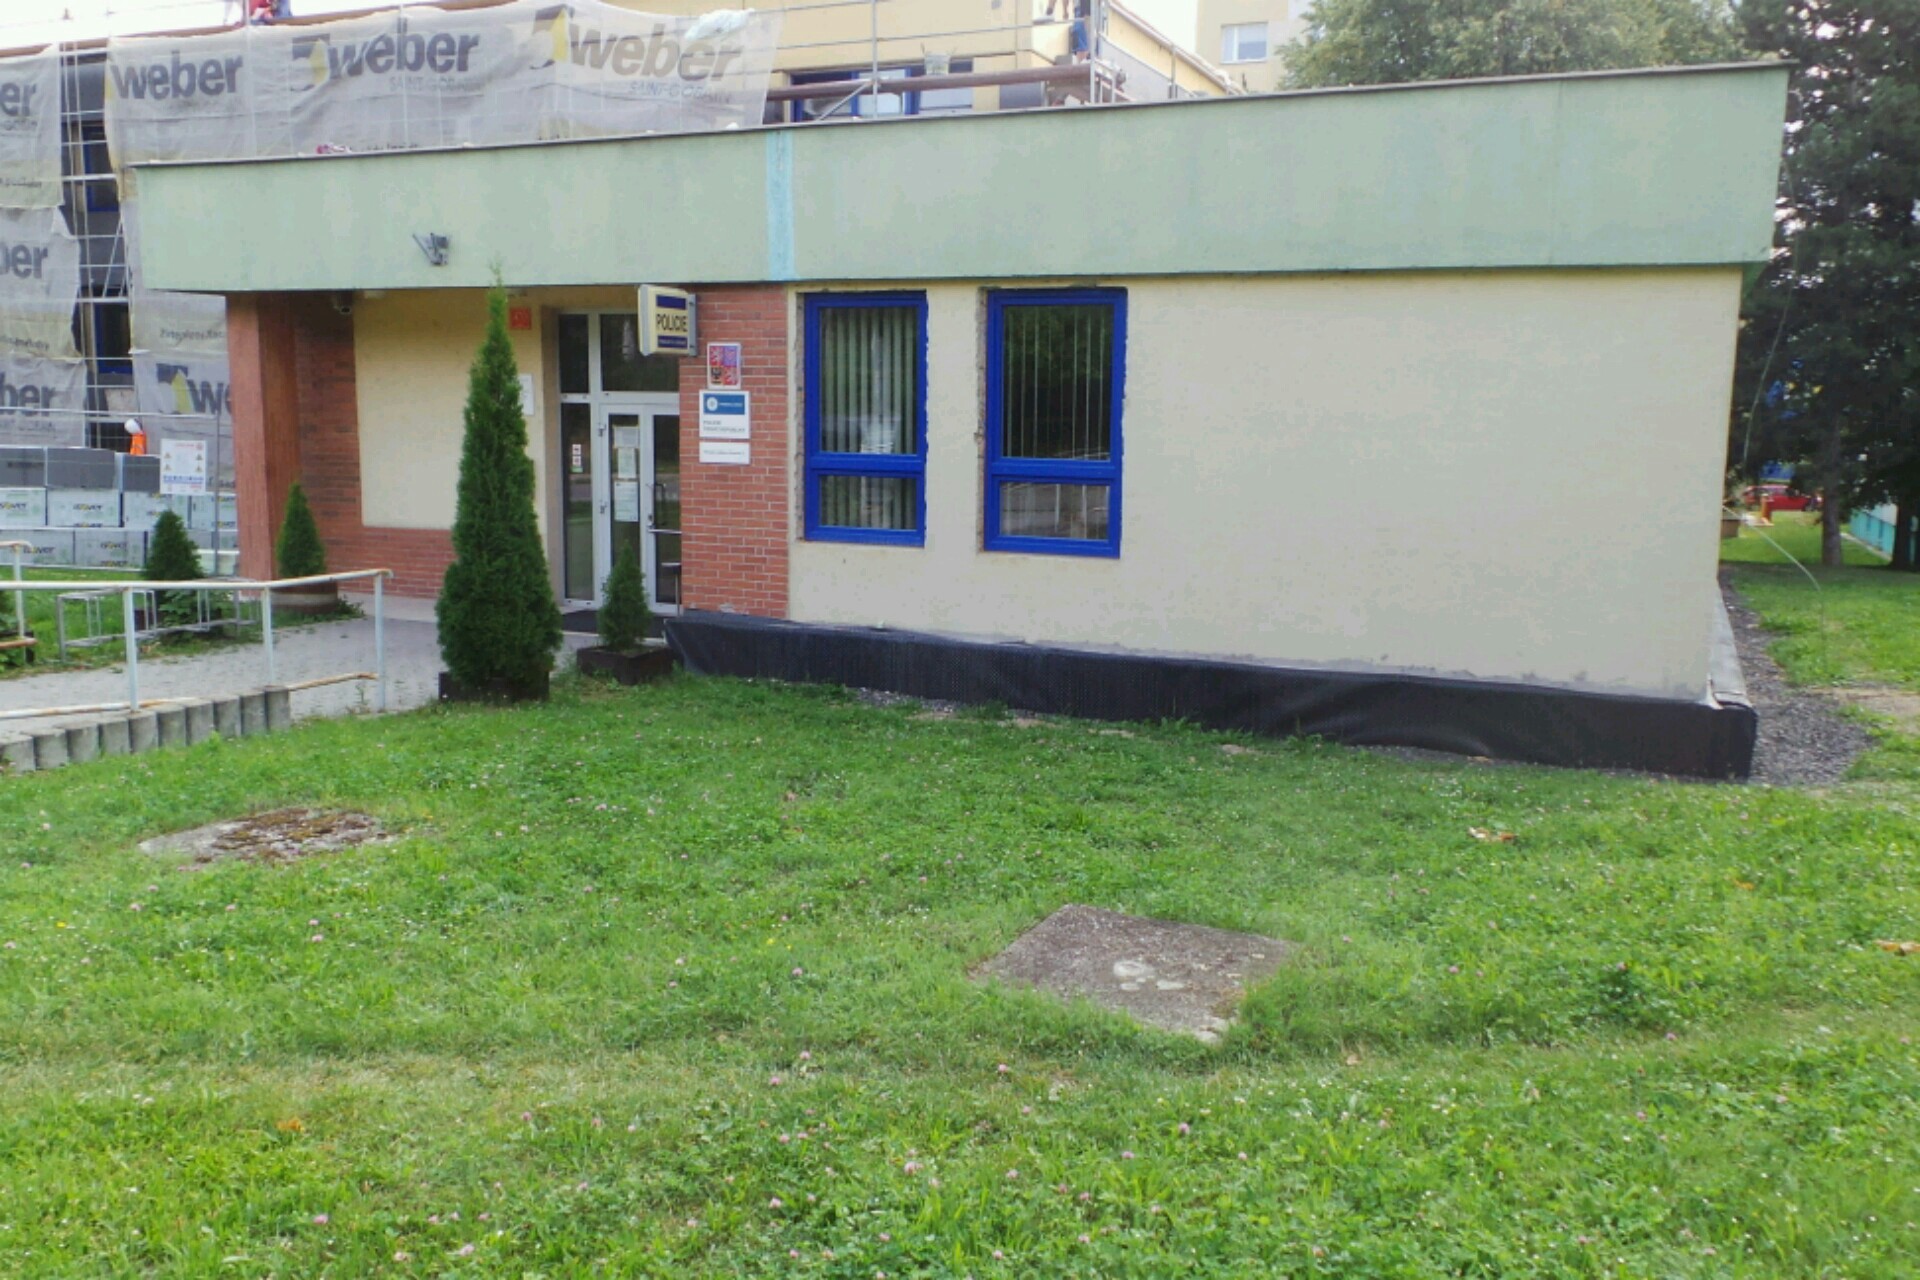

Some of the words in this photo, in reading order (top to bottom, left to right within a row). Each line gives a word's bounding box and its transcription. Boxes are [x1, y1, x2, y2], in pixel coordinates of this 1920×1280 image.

[110, 50, 243, 100] weber
[328, 17, 481, 80] weber
[569, 22, 744, 82] weber
[656, 313, 688, 333] POLICIE
